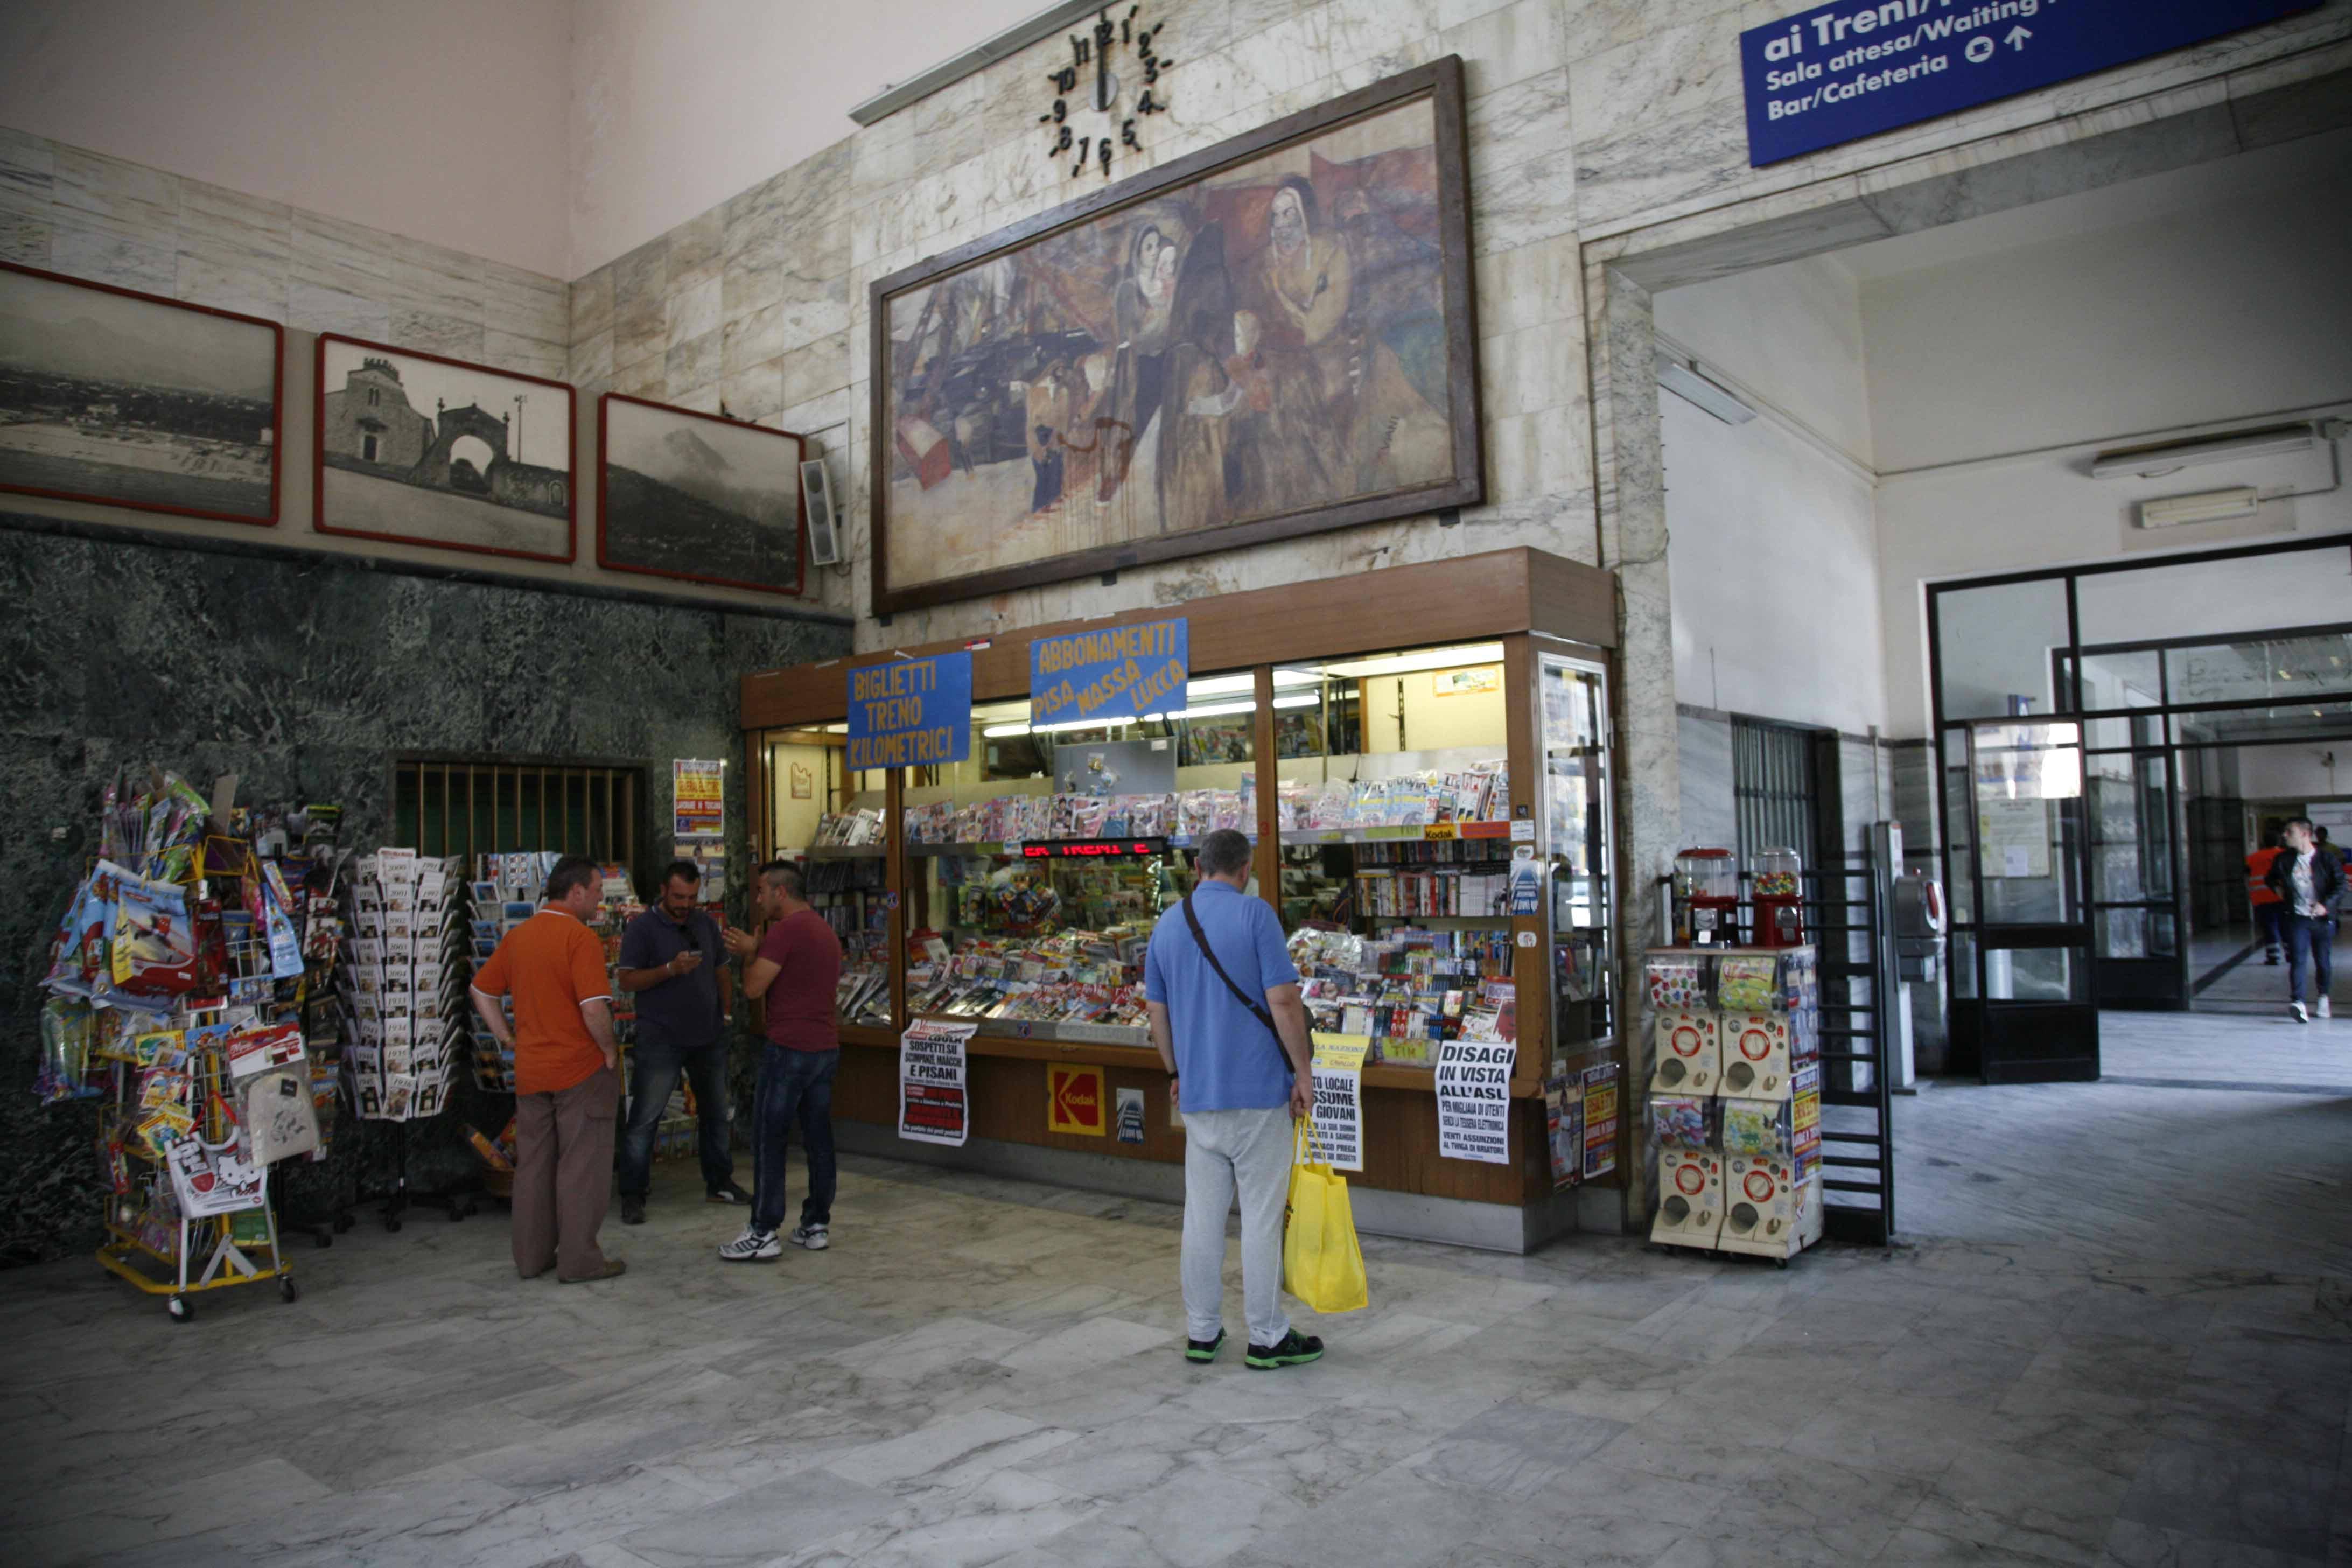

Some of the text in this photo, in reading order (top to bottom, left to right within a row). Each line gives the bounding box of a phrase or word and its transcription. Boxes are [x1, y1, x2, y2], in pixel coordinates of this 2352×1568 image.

[1138, 32, 1152, 58] 2
[1764, 24, 1802, 62] ai
[1766, 0, 2038, 91] Sala attesa/Waiting
[1145, 57, 1158, 83] 3
[1768, 55, 1948, 120] Bar/Cafeteria
[1053, 100, 1066, 123] 9
[1059, 127, 1072, 150] 8
[1099, 138, 1112, 162] 6
[1039, 622, 1175, 675] ABBONAMENTI
[854, 660, 937, 701] BIGLIETTI
[1031, 659, 1186, 721] PISA MASSA LUCCA
[865, 696, 922, 733] TRENO
[850, 725, 953, 767] KILOMETRICI
[1425, 830, 1453, 839] Kodak
[909, 1040, 956, 1054] SOSPETTI SU
[1441, 1046, 1515, 1065] DISAGI
[910, 1065, 916, 1076] E
[919, 1066, 957, 1080] PISANI
[1439, 1065, 1506, 1084] IN VISTA
[1312, 1076, 1353, 1092] TO LOCALE
[1440, 1085, 1507, 1100] ALL'ASL
[1065, 1093, 1095, 1105] Kodak
[1312, 1090, 1354, 1106] SSUME
[1317, 1105, 1355, 1121] GIOVANI
[1442, 1100, 1505, 1117] PER MIGLIAIA DI UTENTI
[1443, 1116, 1453, 1126] SENZA
[1460, 1117, 1476, 1129] TESSERA
[1478, 1119, 1504, 1131] ELETTRONICA
[1336, 1143, 1356, 1152] PREGA
[1443, 1131, 1504, 1145] VENTI ASSUNZIONI
[1451, 1143, 1468, 1151] TWIGA
[1469, 1144, 1476, 1152] DI
[1476, 1145, 1504, 1155] BRIATORE
